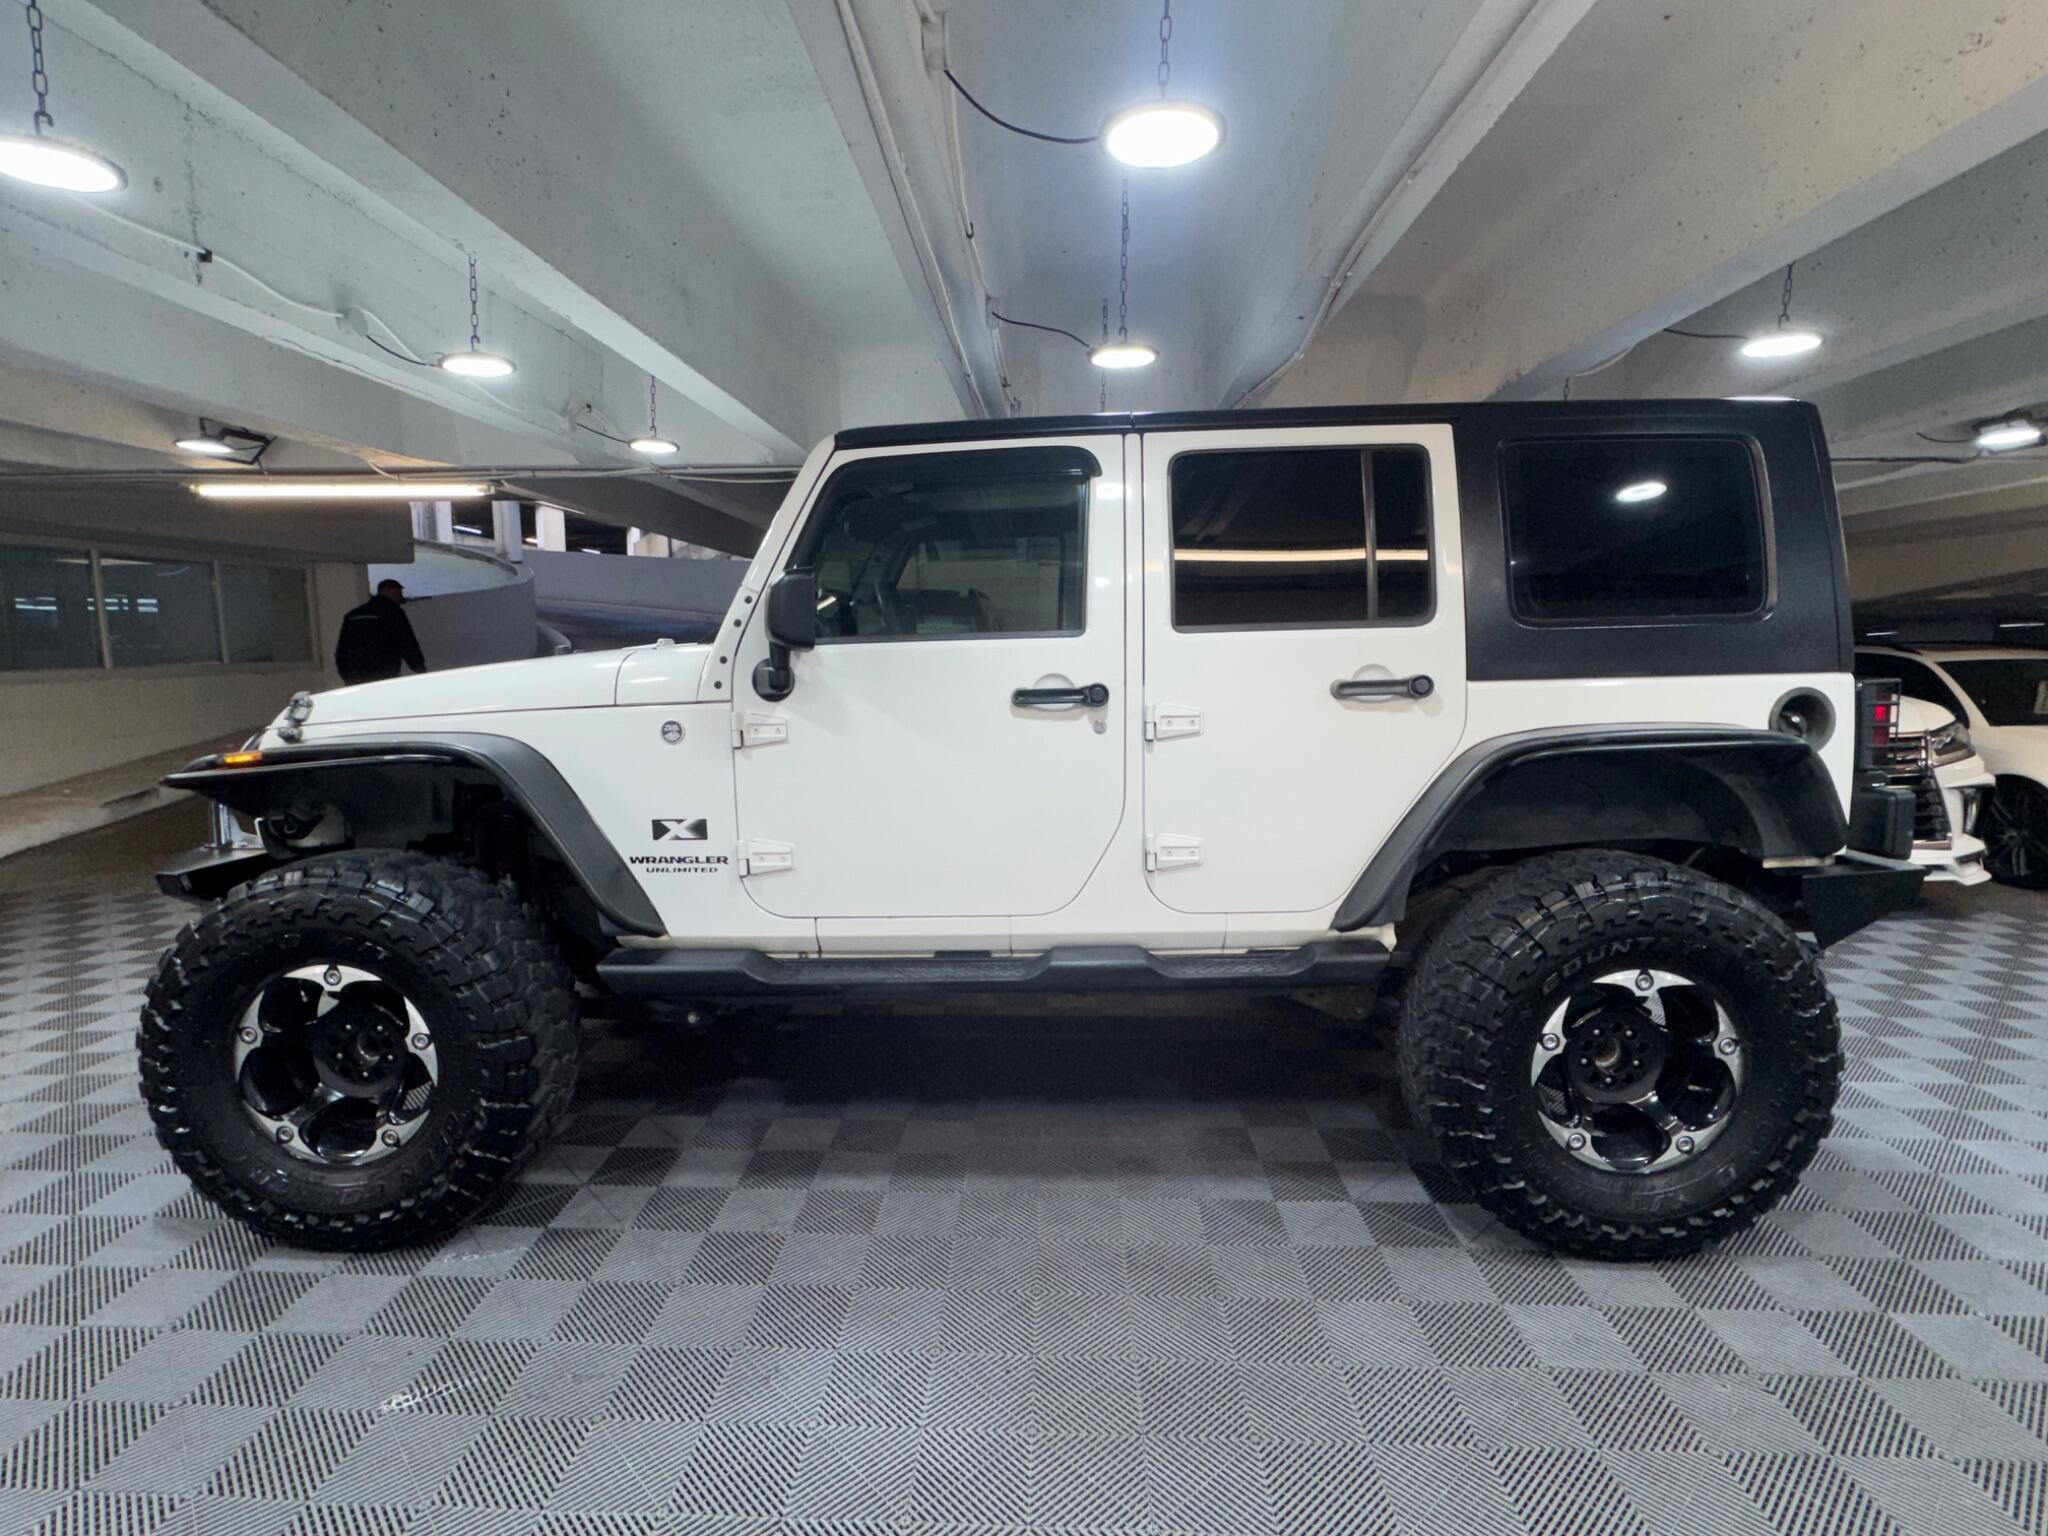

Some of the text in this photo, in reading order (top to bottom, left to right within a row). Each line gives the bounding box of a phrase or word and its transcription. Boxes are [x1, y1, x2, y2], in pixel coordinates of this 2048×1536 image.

[652, 819, 708, 840] X
[629, 856, 729, 865] WRANGLER
[1542, 936, 1700, 996] COUNT
